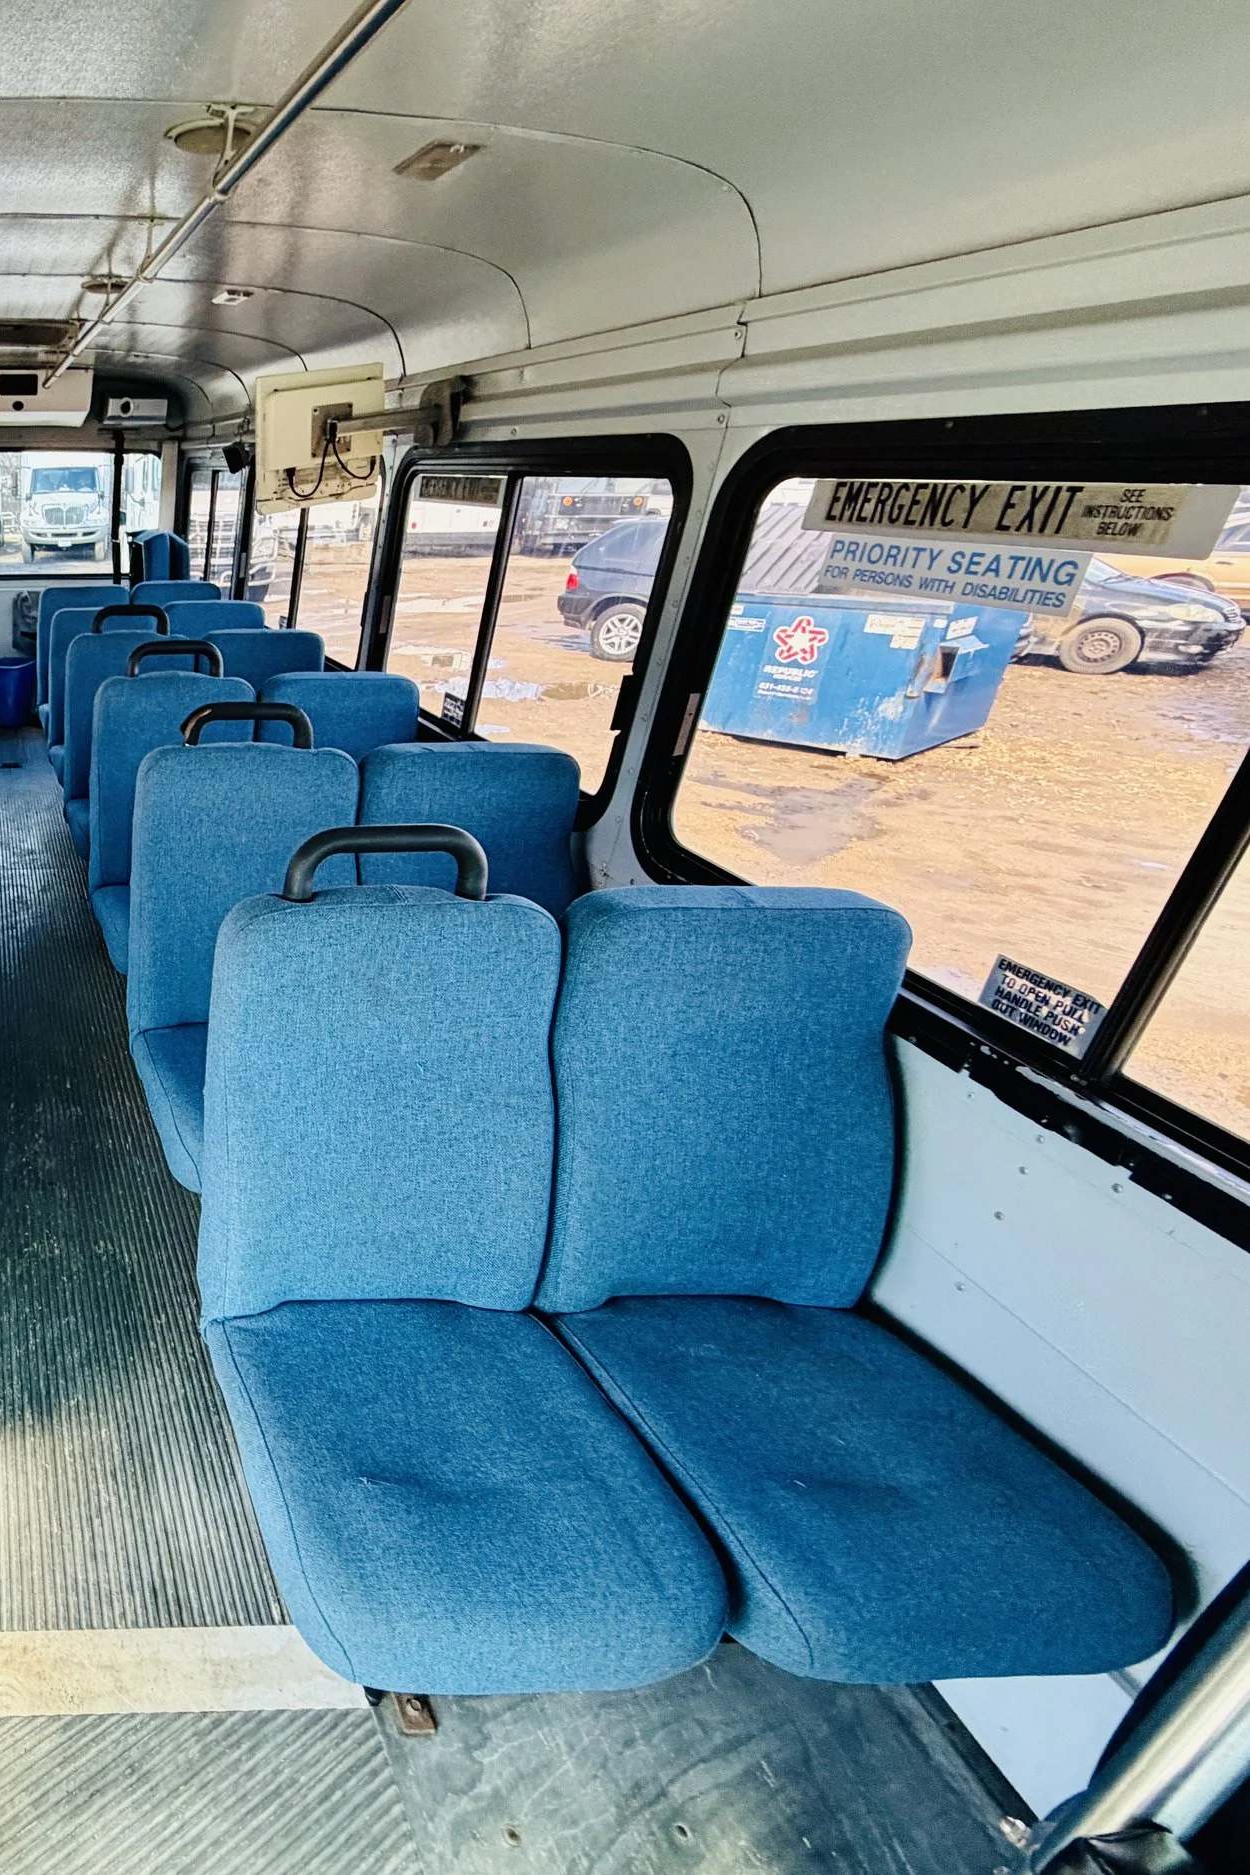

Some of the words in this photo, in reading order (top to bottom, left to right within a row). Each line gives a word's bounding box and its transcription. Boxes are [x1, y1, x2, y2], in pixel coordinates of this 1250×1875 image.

[825, 481, 991, 529] EMERGENCY
[995, 485, 1085, 535] EXIT
[1082, 504, 1175, 522] INSTRUCTIONS
[1120, 489, 1146, 503] SEE
[1096, 522, 1143, 537] BELOW
[824, 565, 849, 580] FOR
[852, 568, 914, 589] PERSONS
[918, 577, 956, 595] WITH
[961, 582, 1066, 608] DISABILITIES
[829, 540, 944, 571] PRIORITY
[946, 551, 1080, 587] SEATING
[763, 665, 817, 678] REPUBLIC
[997, 958, 1072, 999] EMERGENCY
[1071, 992, 1102, 1015] EXIT
[1000, 973, 1017, 989] TO
[1018, 983, 1052, 1006] OPEN
[1052, 1000, 1085, 1024] PULL
[991, 998, 1019, 1018] OUT
[1018, 1011, 1072, 1047] WINDOW
[994, 985, 1043, 1017] HANDLE
[1043, 1010, 1080, 1036] PUSH
